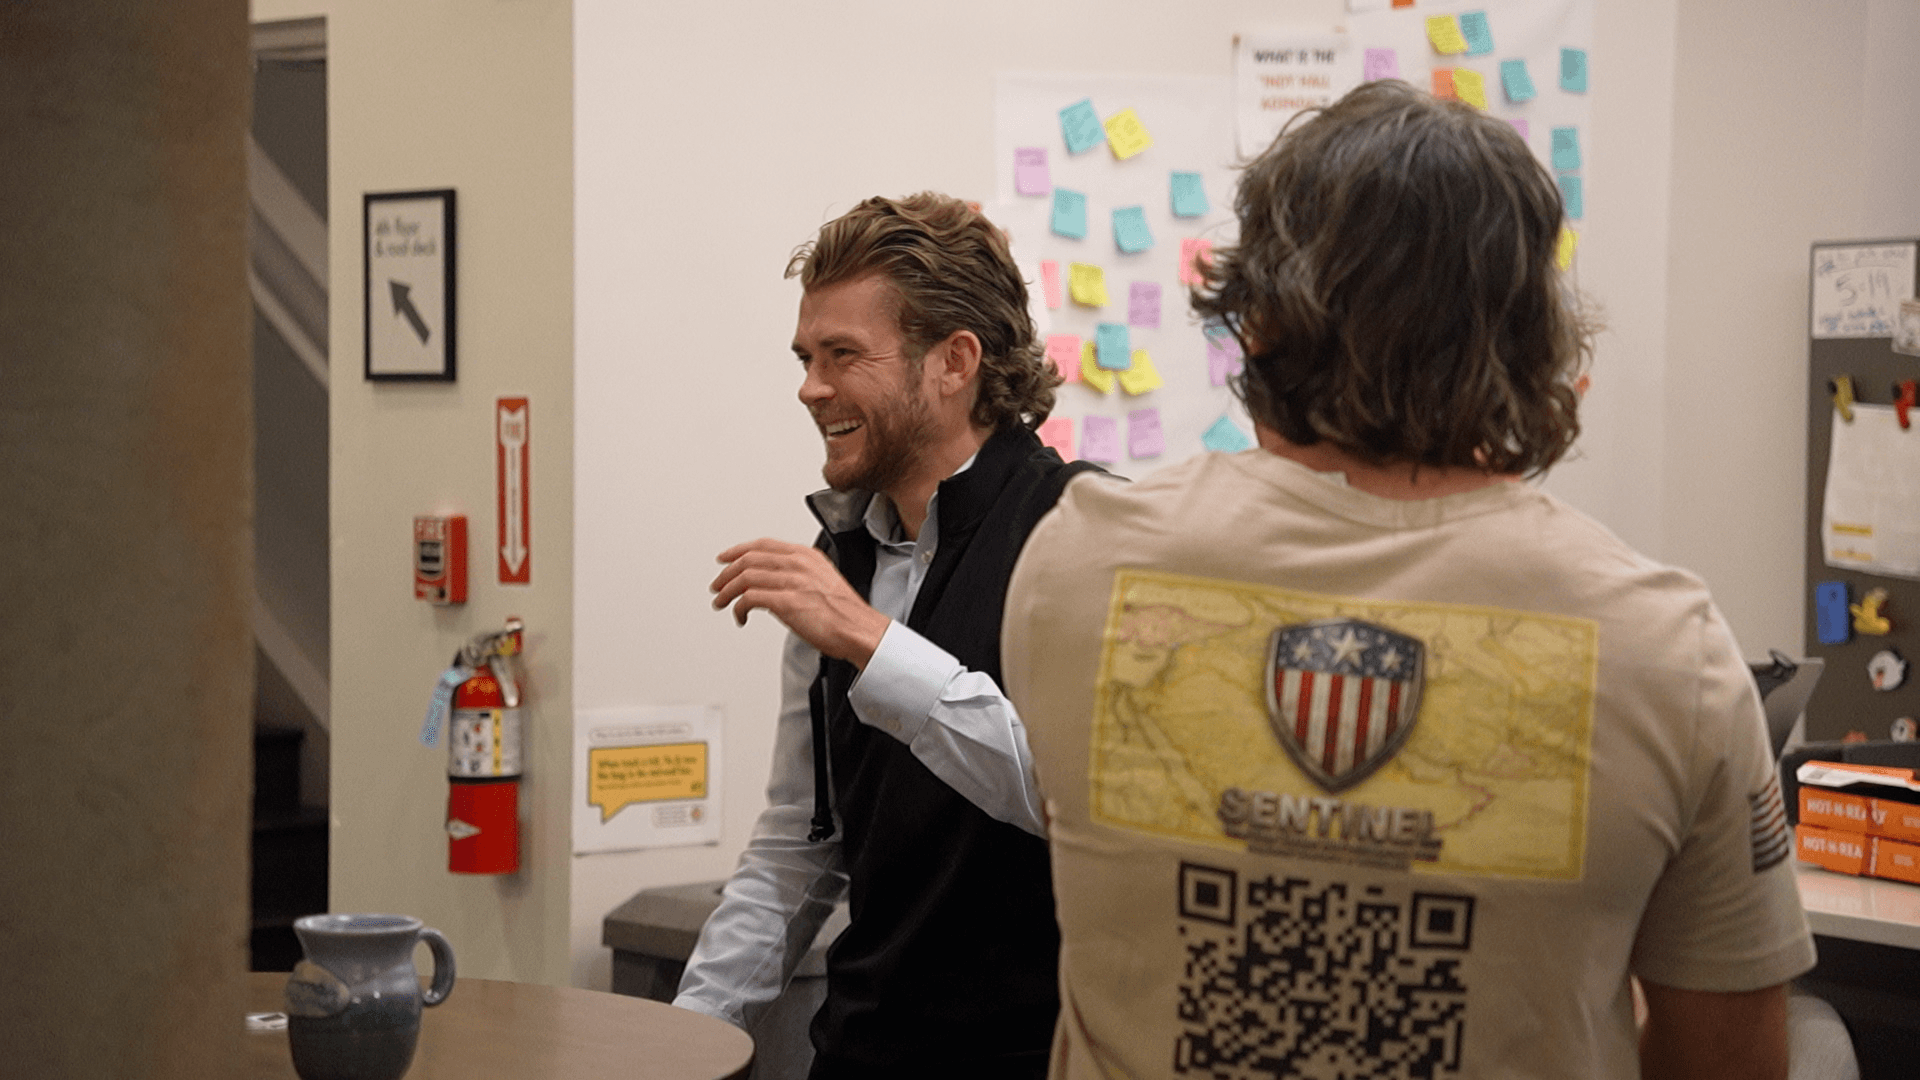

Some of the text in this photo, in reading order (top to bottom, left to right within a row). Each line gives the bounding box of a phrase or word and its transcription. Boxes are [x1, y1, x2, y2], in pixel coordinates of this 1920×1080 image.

[1254, 49, 1293, 64] WHAT
[1314, 49, 1336, 63] THE
[415, 521, 444, 540] FIRE
[1217, 787, 1442, 847] SENTINEL
